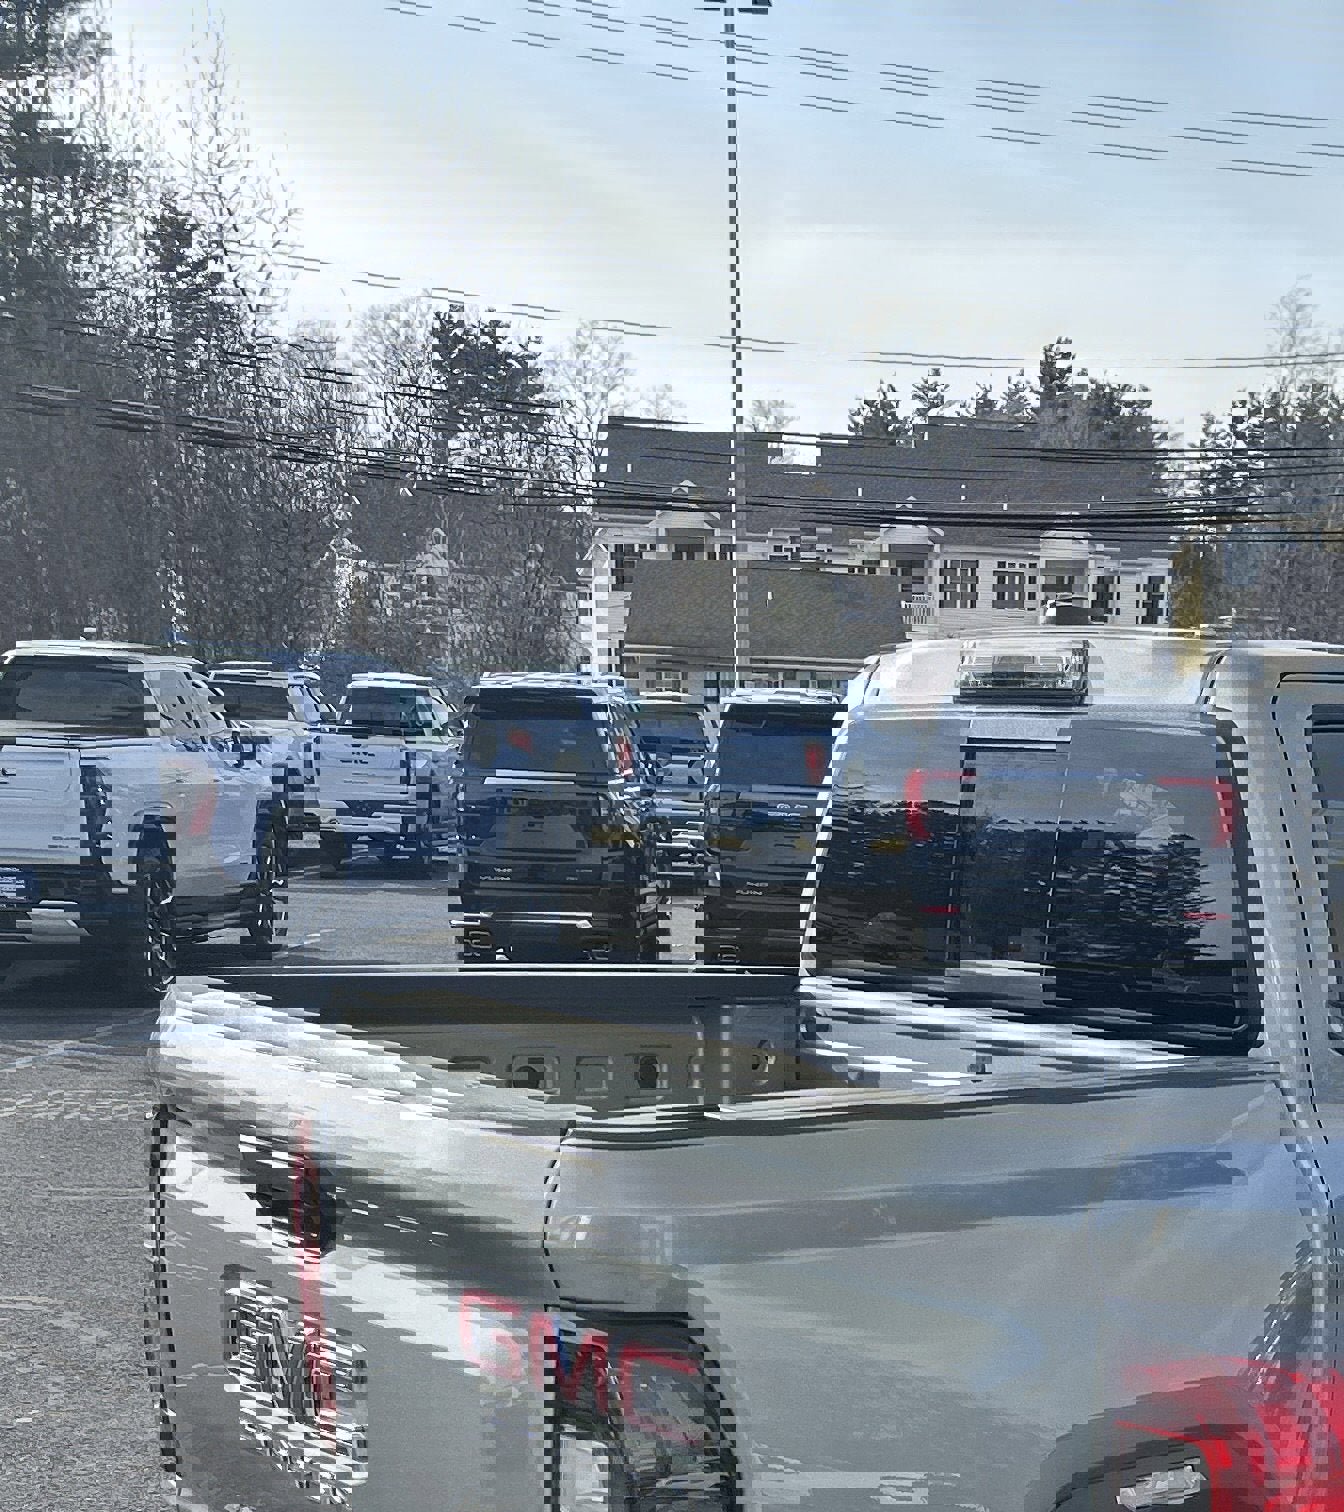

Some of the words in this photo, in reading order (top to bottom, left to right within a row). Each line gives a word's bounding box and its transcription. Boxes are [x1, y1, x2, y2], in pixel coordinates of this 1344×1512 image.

[691, 745, 744, 757] GMC
[1024, 790, 1109, 800] DENALI
[458, 1274, 720, 1458] GMC
